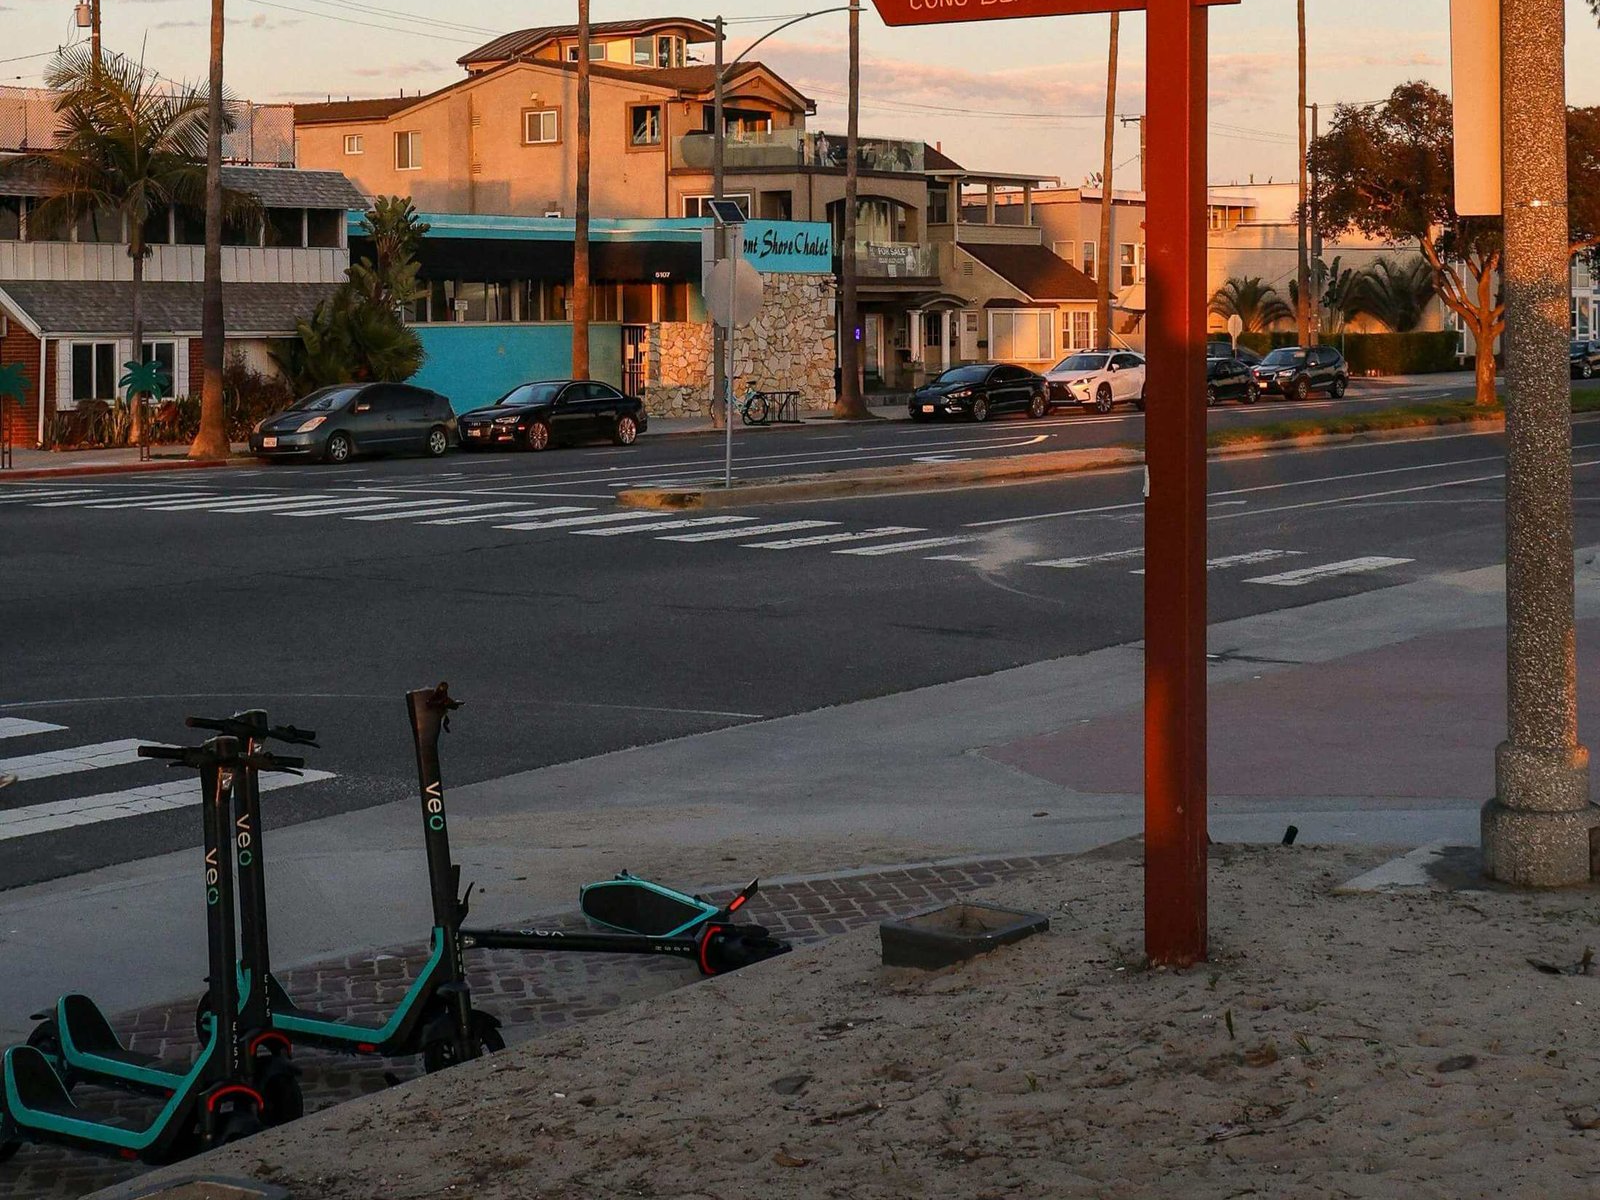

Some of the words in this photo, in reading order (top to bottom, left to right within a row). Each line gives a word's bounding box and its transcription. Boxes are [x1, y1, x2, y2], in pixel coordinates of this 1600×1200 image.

[759, 228, 793, 258] Shore
[794, 231, 829, 256] Chalet
[877, 247, 890, 256] FOR
[890, 247, 906, 256] SALE
[425, 781, 444, 830] veo
[236, 813, 252, 866] veo
[205, 847, 219, 905] veo
[263, 974, 271, 1018] E175
